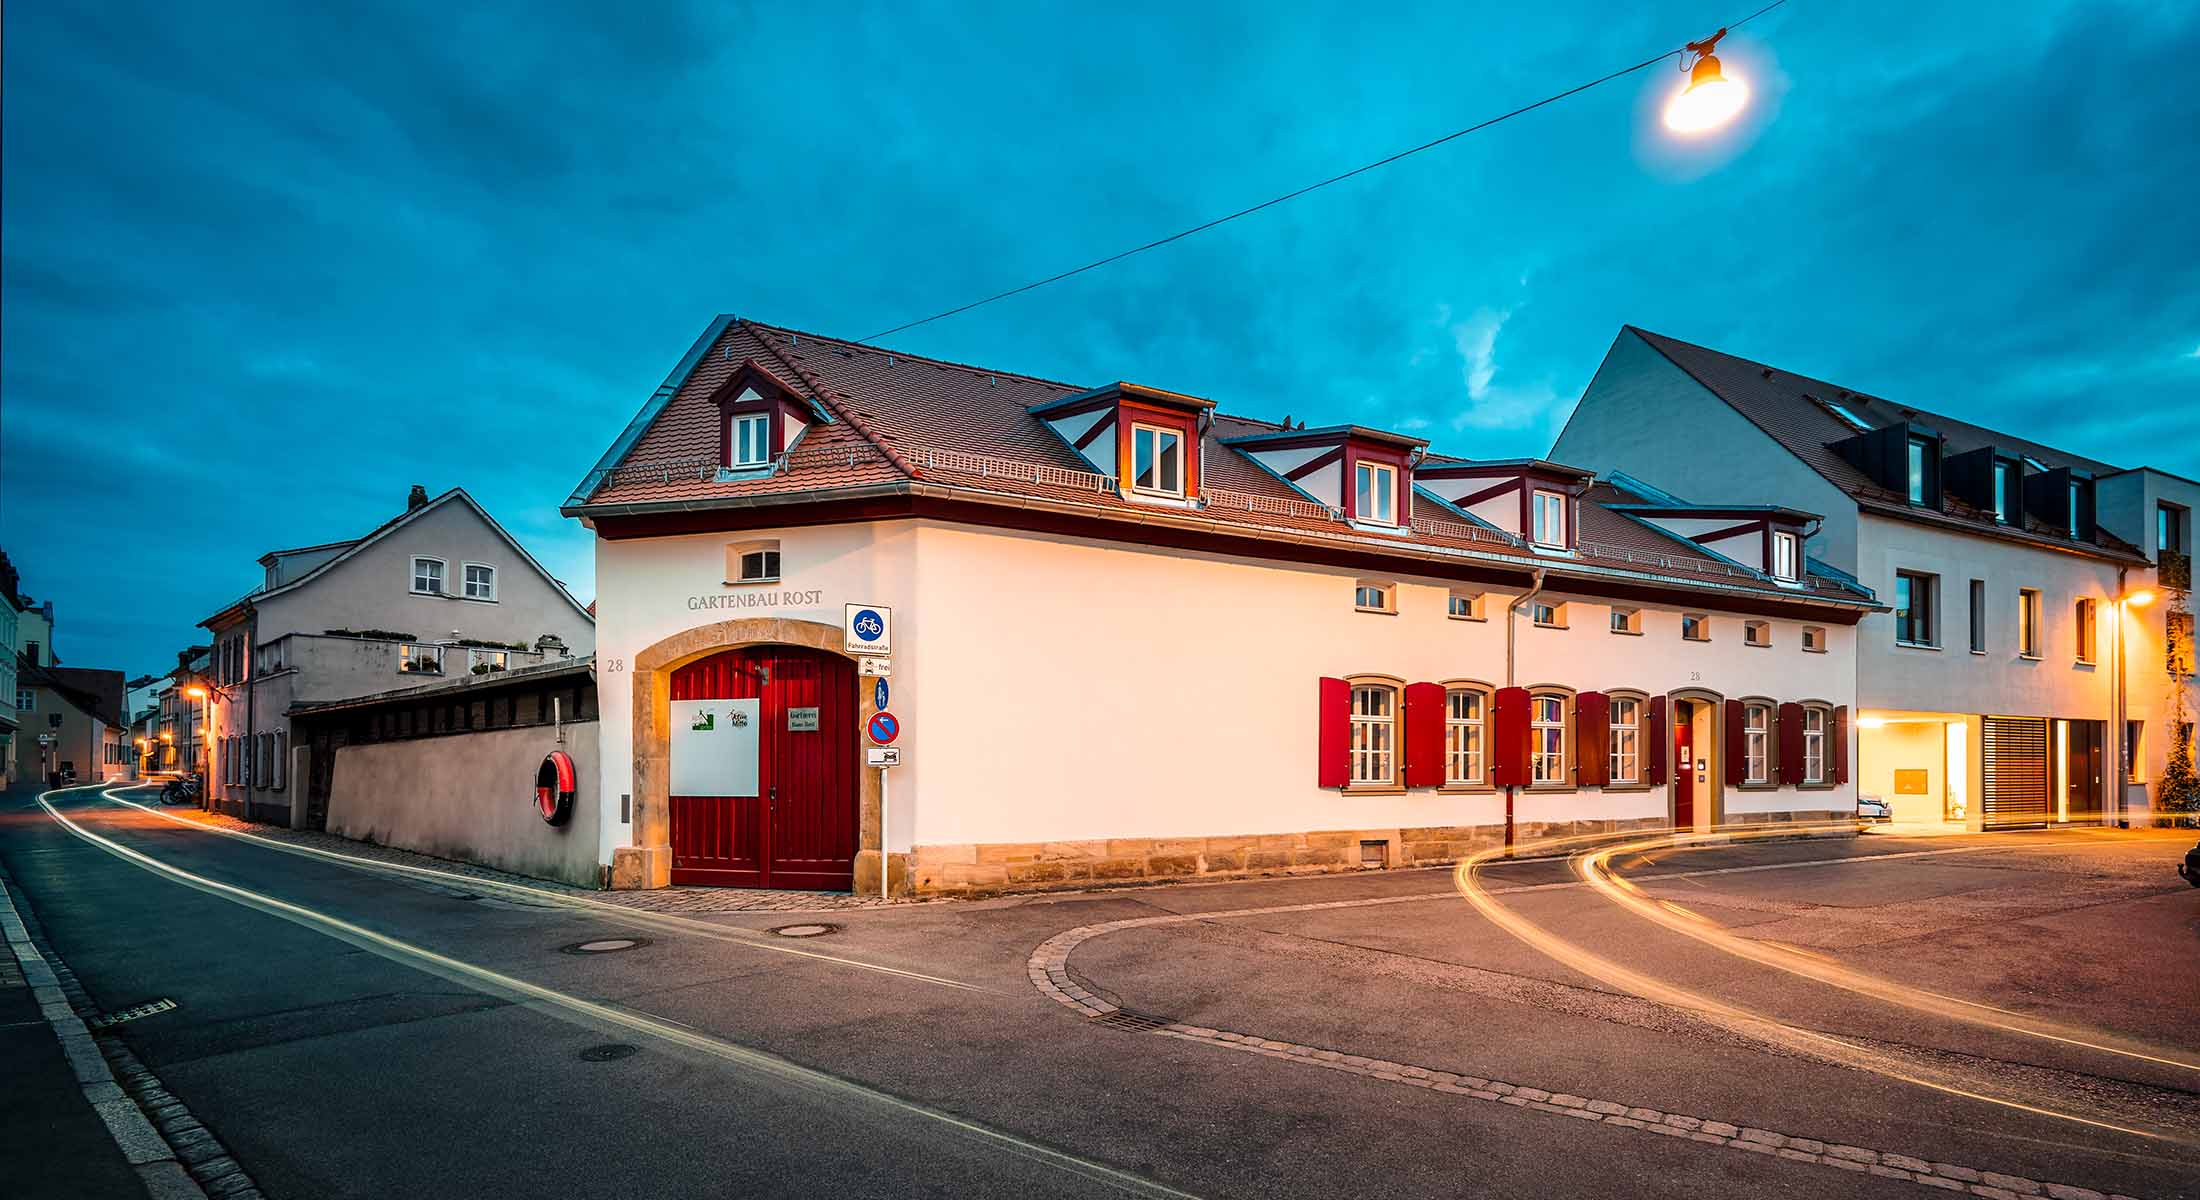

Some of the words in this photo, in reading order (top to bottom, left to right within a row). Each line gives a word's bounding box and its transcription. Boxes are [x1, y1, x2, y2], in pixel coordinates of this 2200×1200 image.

[687, 591, 778, 610] GARTENBAU
[783, 590, 823, 606] ROST
[848, 642, 889, 651] Fahrradstraße
[607, 658, 624, 673] 28
[878, 663, 890, 671] frei
[1690, 671, 1701, 681] 28
